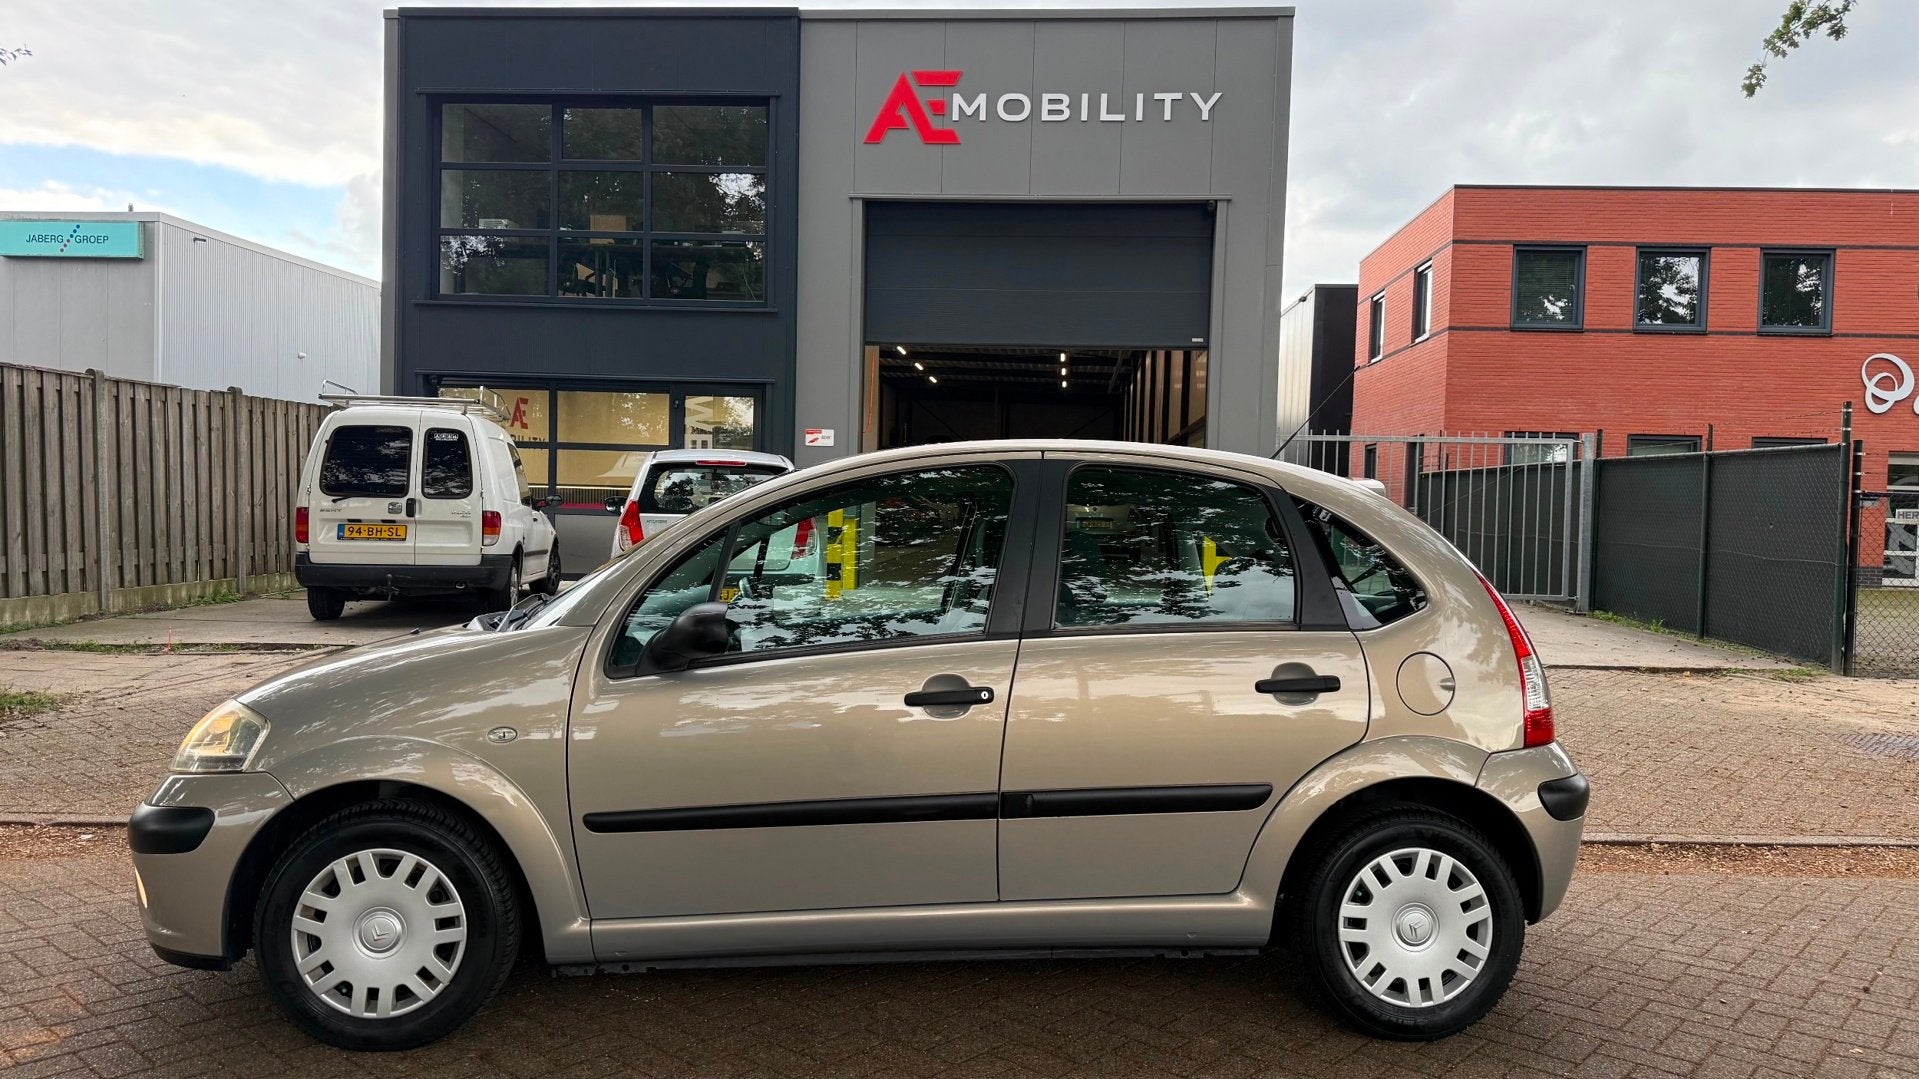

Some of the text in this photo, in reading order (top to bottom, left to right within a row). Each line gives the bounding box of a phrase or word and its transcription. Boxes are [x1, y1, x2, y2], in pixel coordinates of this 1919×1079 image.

[951, 92, 1223, 122] MOBILITY
[25, 234, 109, 244] JABERG GROEP
[347, 526, 402, 537] 94-BH-SL
